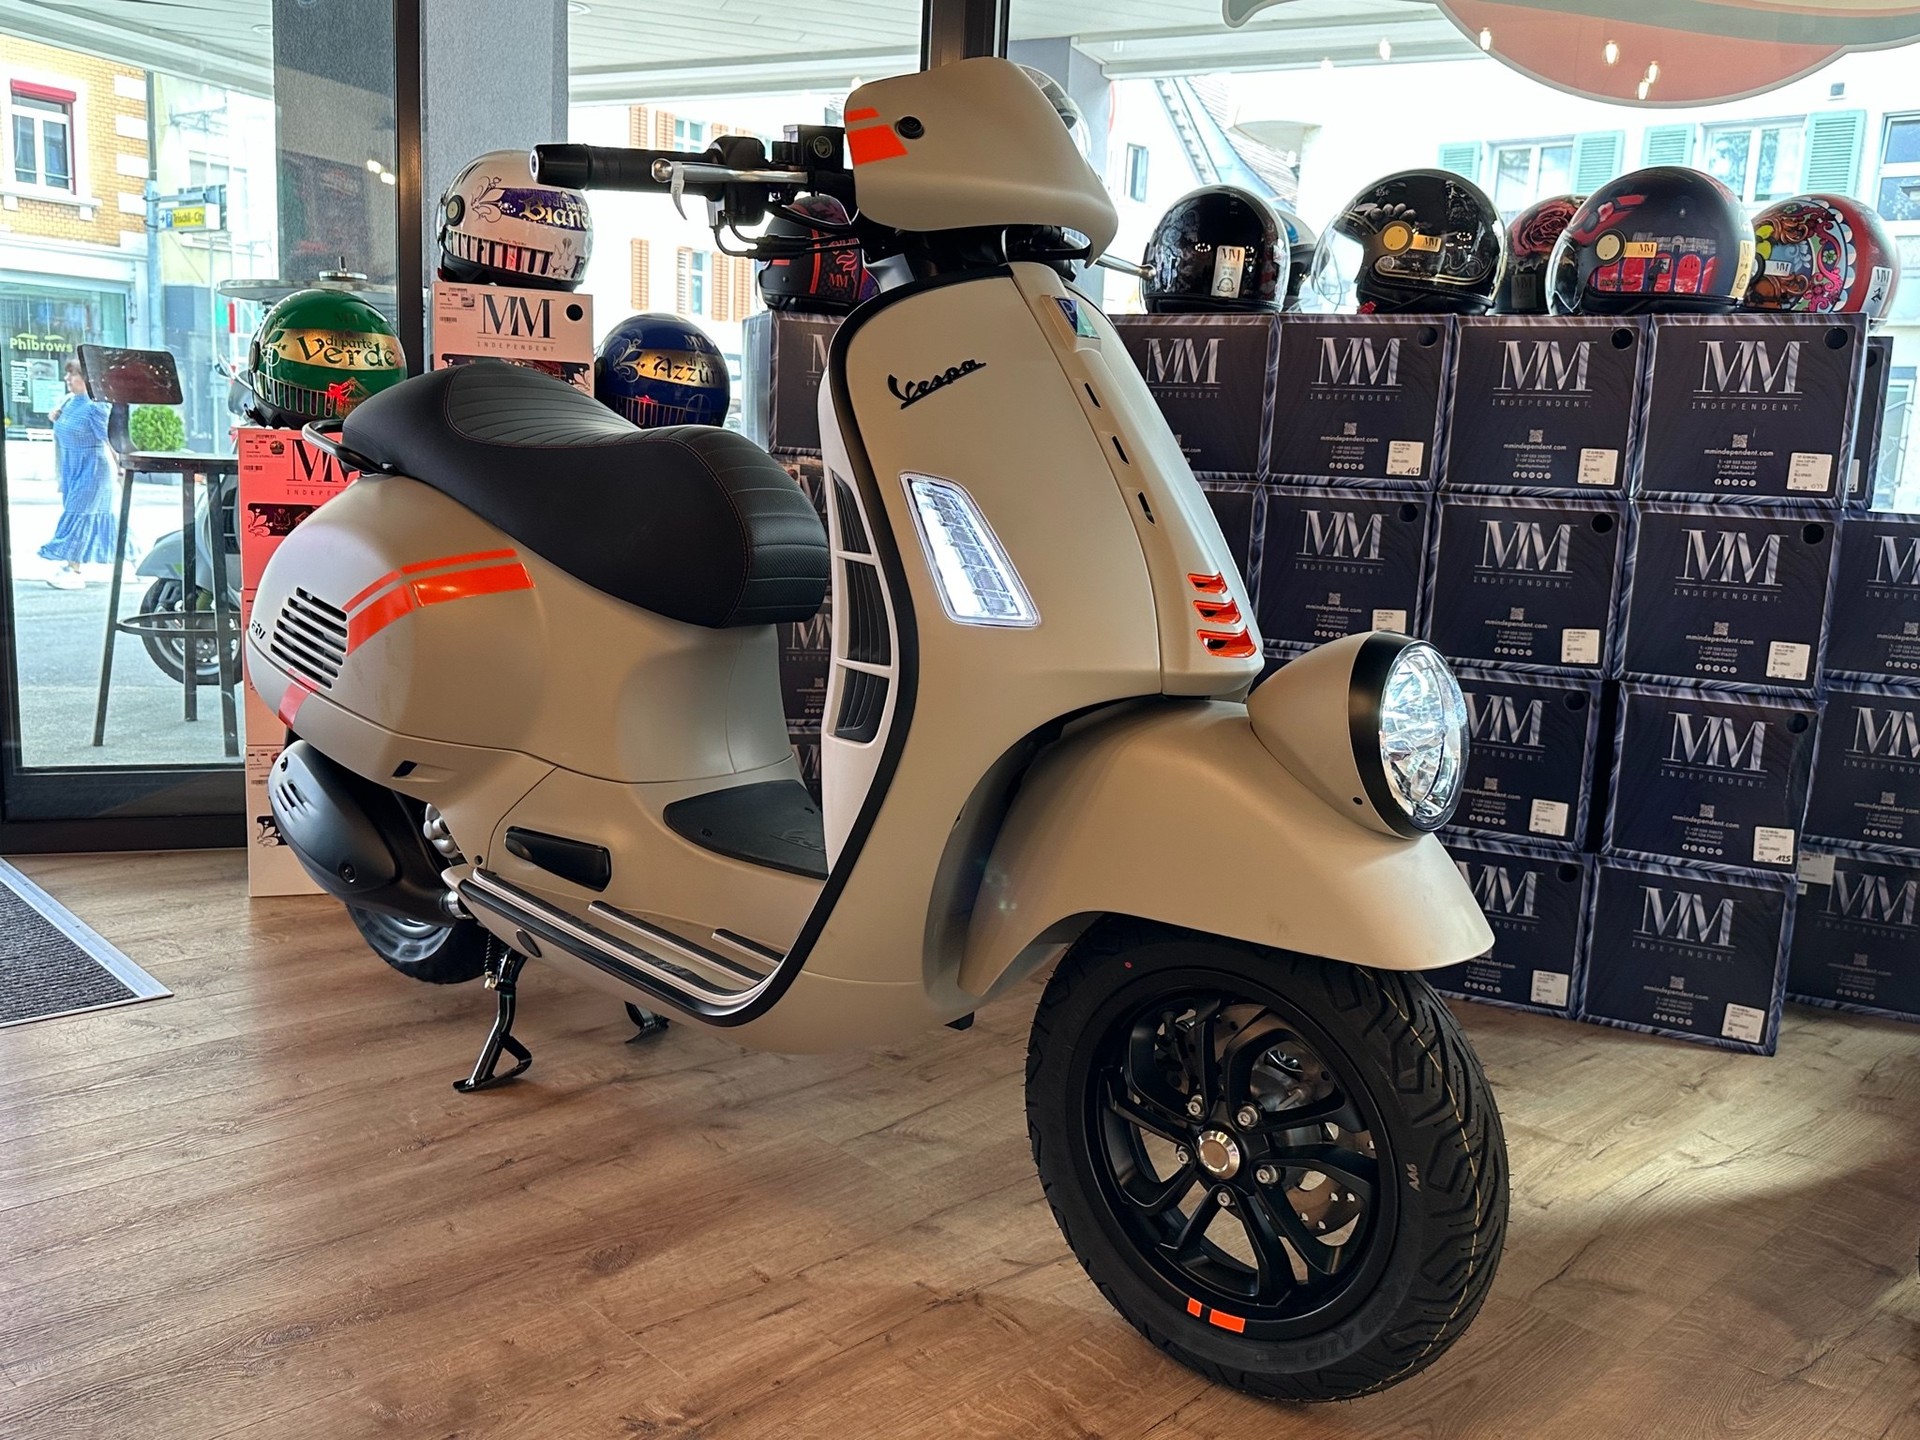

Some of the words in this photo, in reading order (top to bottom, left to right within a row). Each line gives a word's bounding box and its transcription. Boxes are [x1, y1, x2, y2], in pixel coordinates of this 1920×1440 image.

[477, 293, 556, 339] MM
[296, 335, 396, 367] Verde
[341, 338, 373, 350] parte
[1143, 338, 1224, 384] MM
[1311, 337, 1407, 386] MM
[1493, 340, 1598, 391] MM
[1692, 340, 1809, 394] MM
[887, 359, 987, 410] Vespa
[1503, 443, 1567, 451] mmindependent.com
[1703, 448, 1774, 457] mmindependent.com
[1296, 509, 1390, 560] MM
[1474, 519, 1579, 573] MM
[1674, 528, 1789, 586] MM
[1865, 591, 1920, 601] INDEPE
[1685, 634, 1754, 645] mmindependent.com
[1662, 711, 1774, 772] MM
[1632, 885, 1743, 948] MM
[1819, 870, 1918, 926] MM
